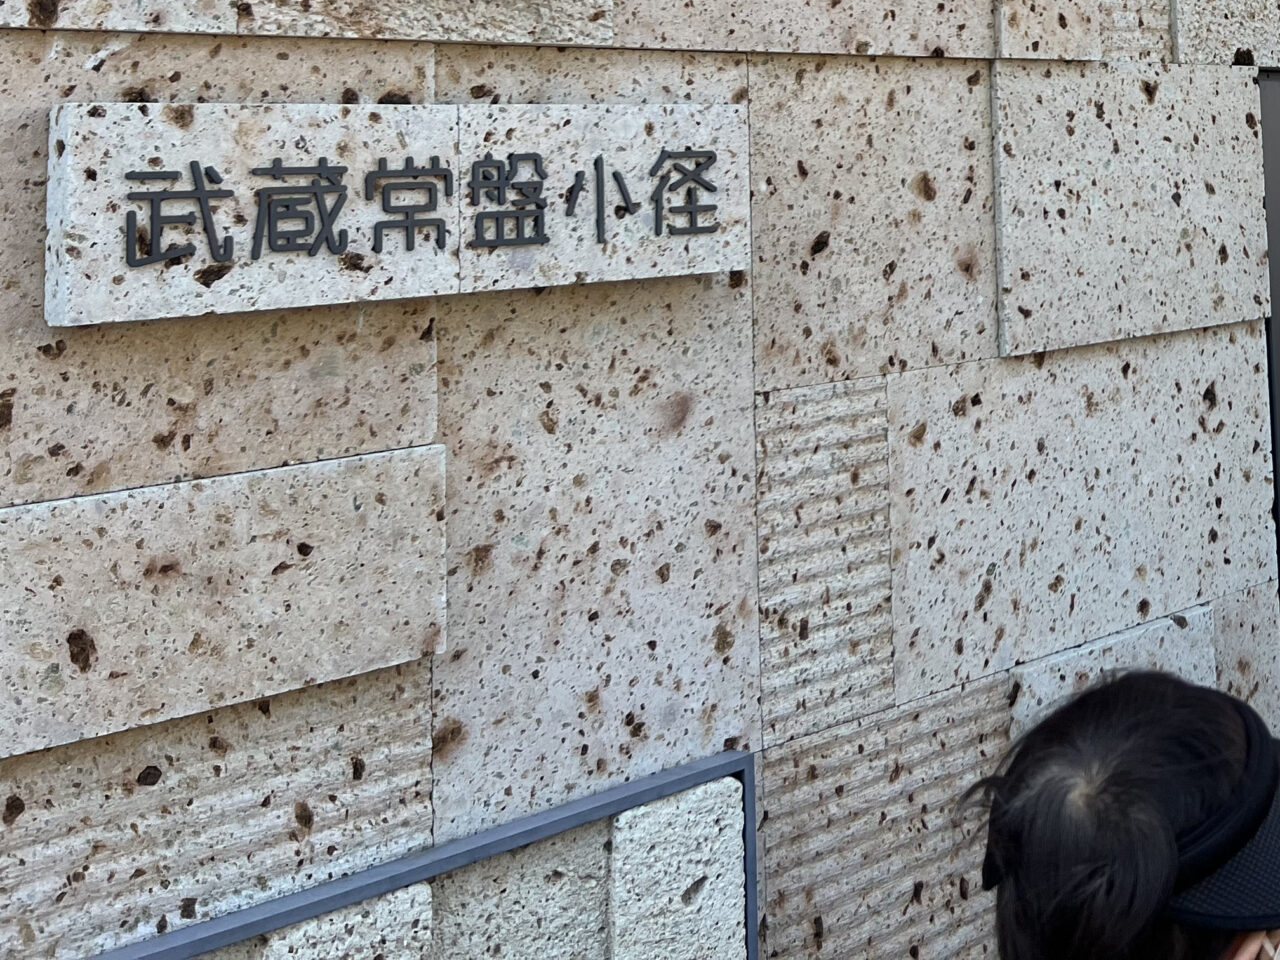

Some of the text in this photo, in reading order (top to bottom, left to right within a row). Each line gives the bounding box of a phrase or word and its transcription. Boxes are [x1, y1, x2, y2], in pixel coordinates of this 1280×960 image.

[125, 149, 718, 268] 武蔵常盤小径
